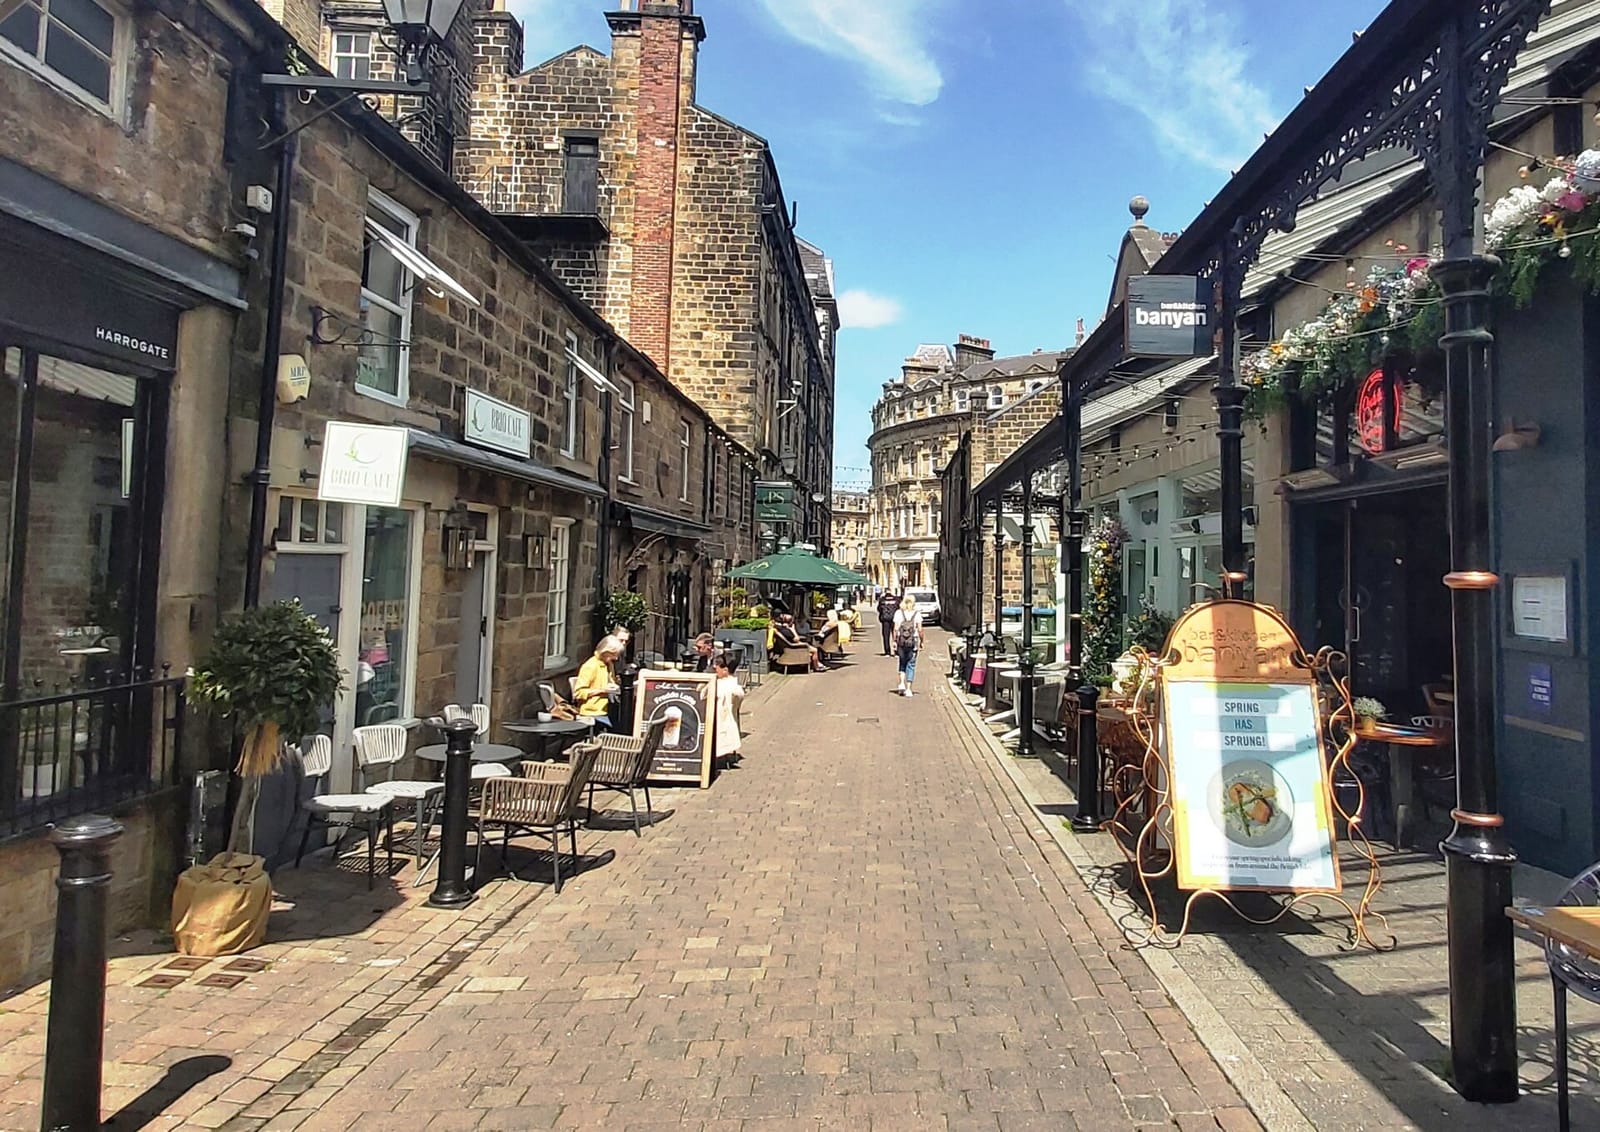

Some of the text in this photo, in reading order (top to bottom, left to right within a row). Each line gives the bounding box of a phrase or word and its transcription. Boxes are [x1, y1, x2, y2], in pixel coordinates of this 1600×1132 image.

[1135, 307, 1207, 329] banyan
[95, 327, 169, 359] HARROGATE
[491, 408, 507, 433] BRIO
[330, 469, 361, 486] BRIO
[1182, 639, 1289, 669] banyan
[1224, 702, 1260, 713] SPRING
[1234, 719, 1253, 730] HAS
[1224, 736, 1266, 747] SPRUNG!
